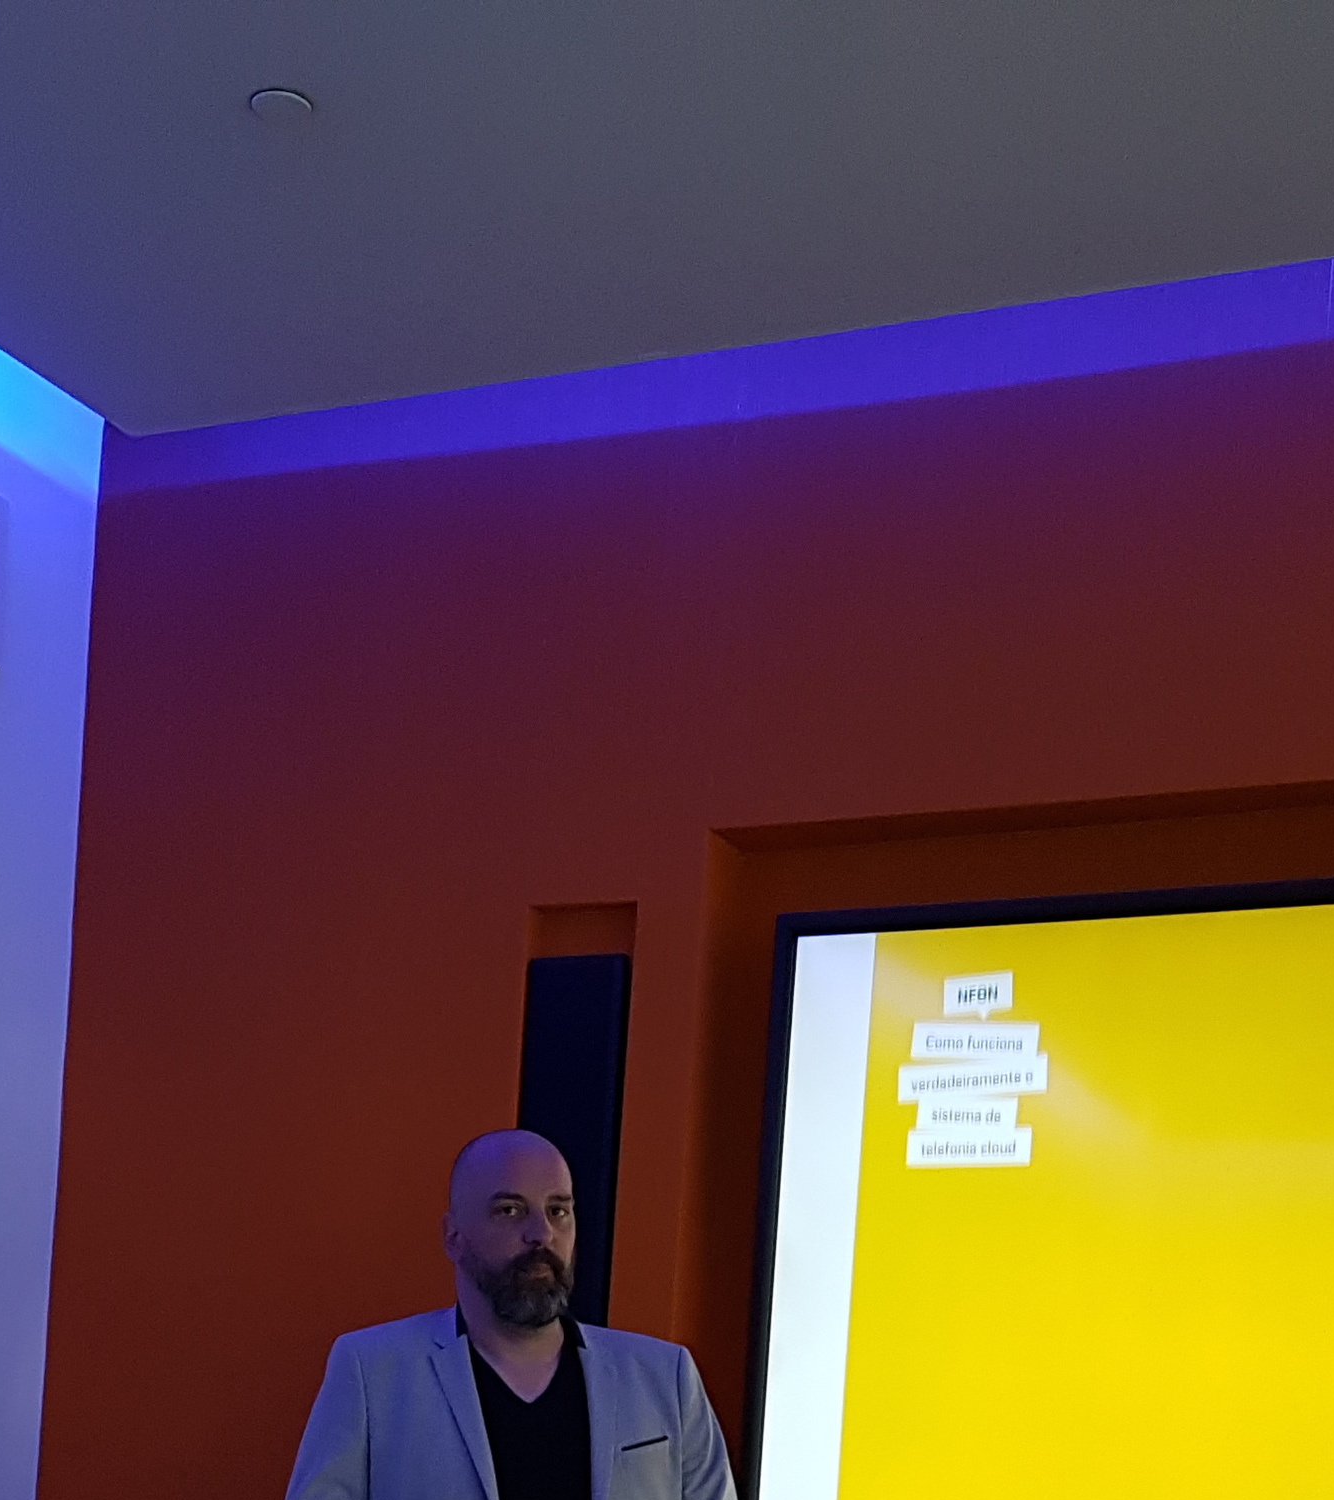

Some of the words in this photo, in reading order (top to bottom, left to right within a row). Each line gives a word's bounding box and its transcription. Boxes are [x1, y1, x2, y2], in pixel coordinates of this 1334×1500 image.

[957, 985, 999, 1004] NFON
[925, 1034, 964, 1050] Como
[967, 1035, 1023, 1051] funciona
[911, 1072, 1021, 1092] verdadeiramente
[1025, 1071, 1034, 1082] o
[931, 1107, 982, 1122] sistema
[985, 1107, 1001, 1122] de
[921, 1140, 977, 1155] telefonia
[980, 1139, 1016, 1154] cloud
